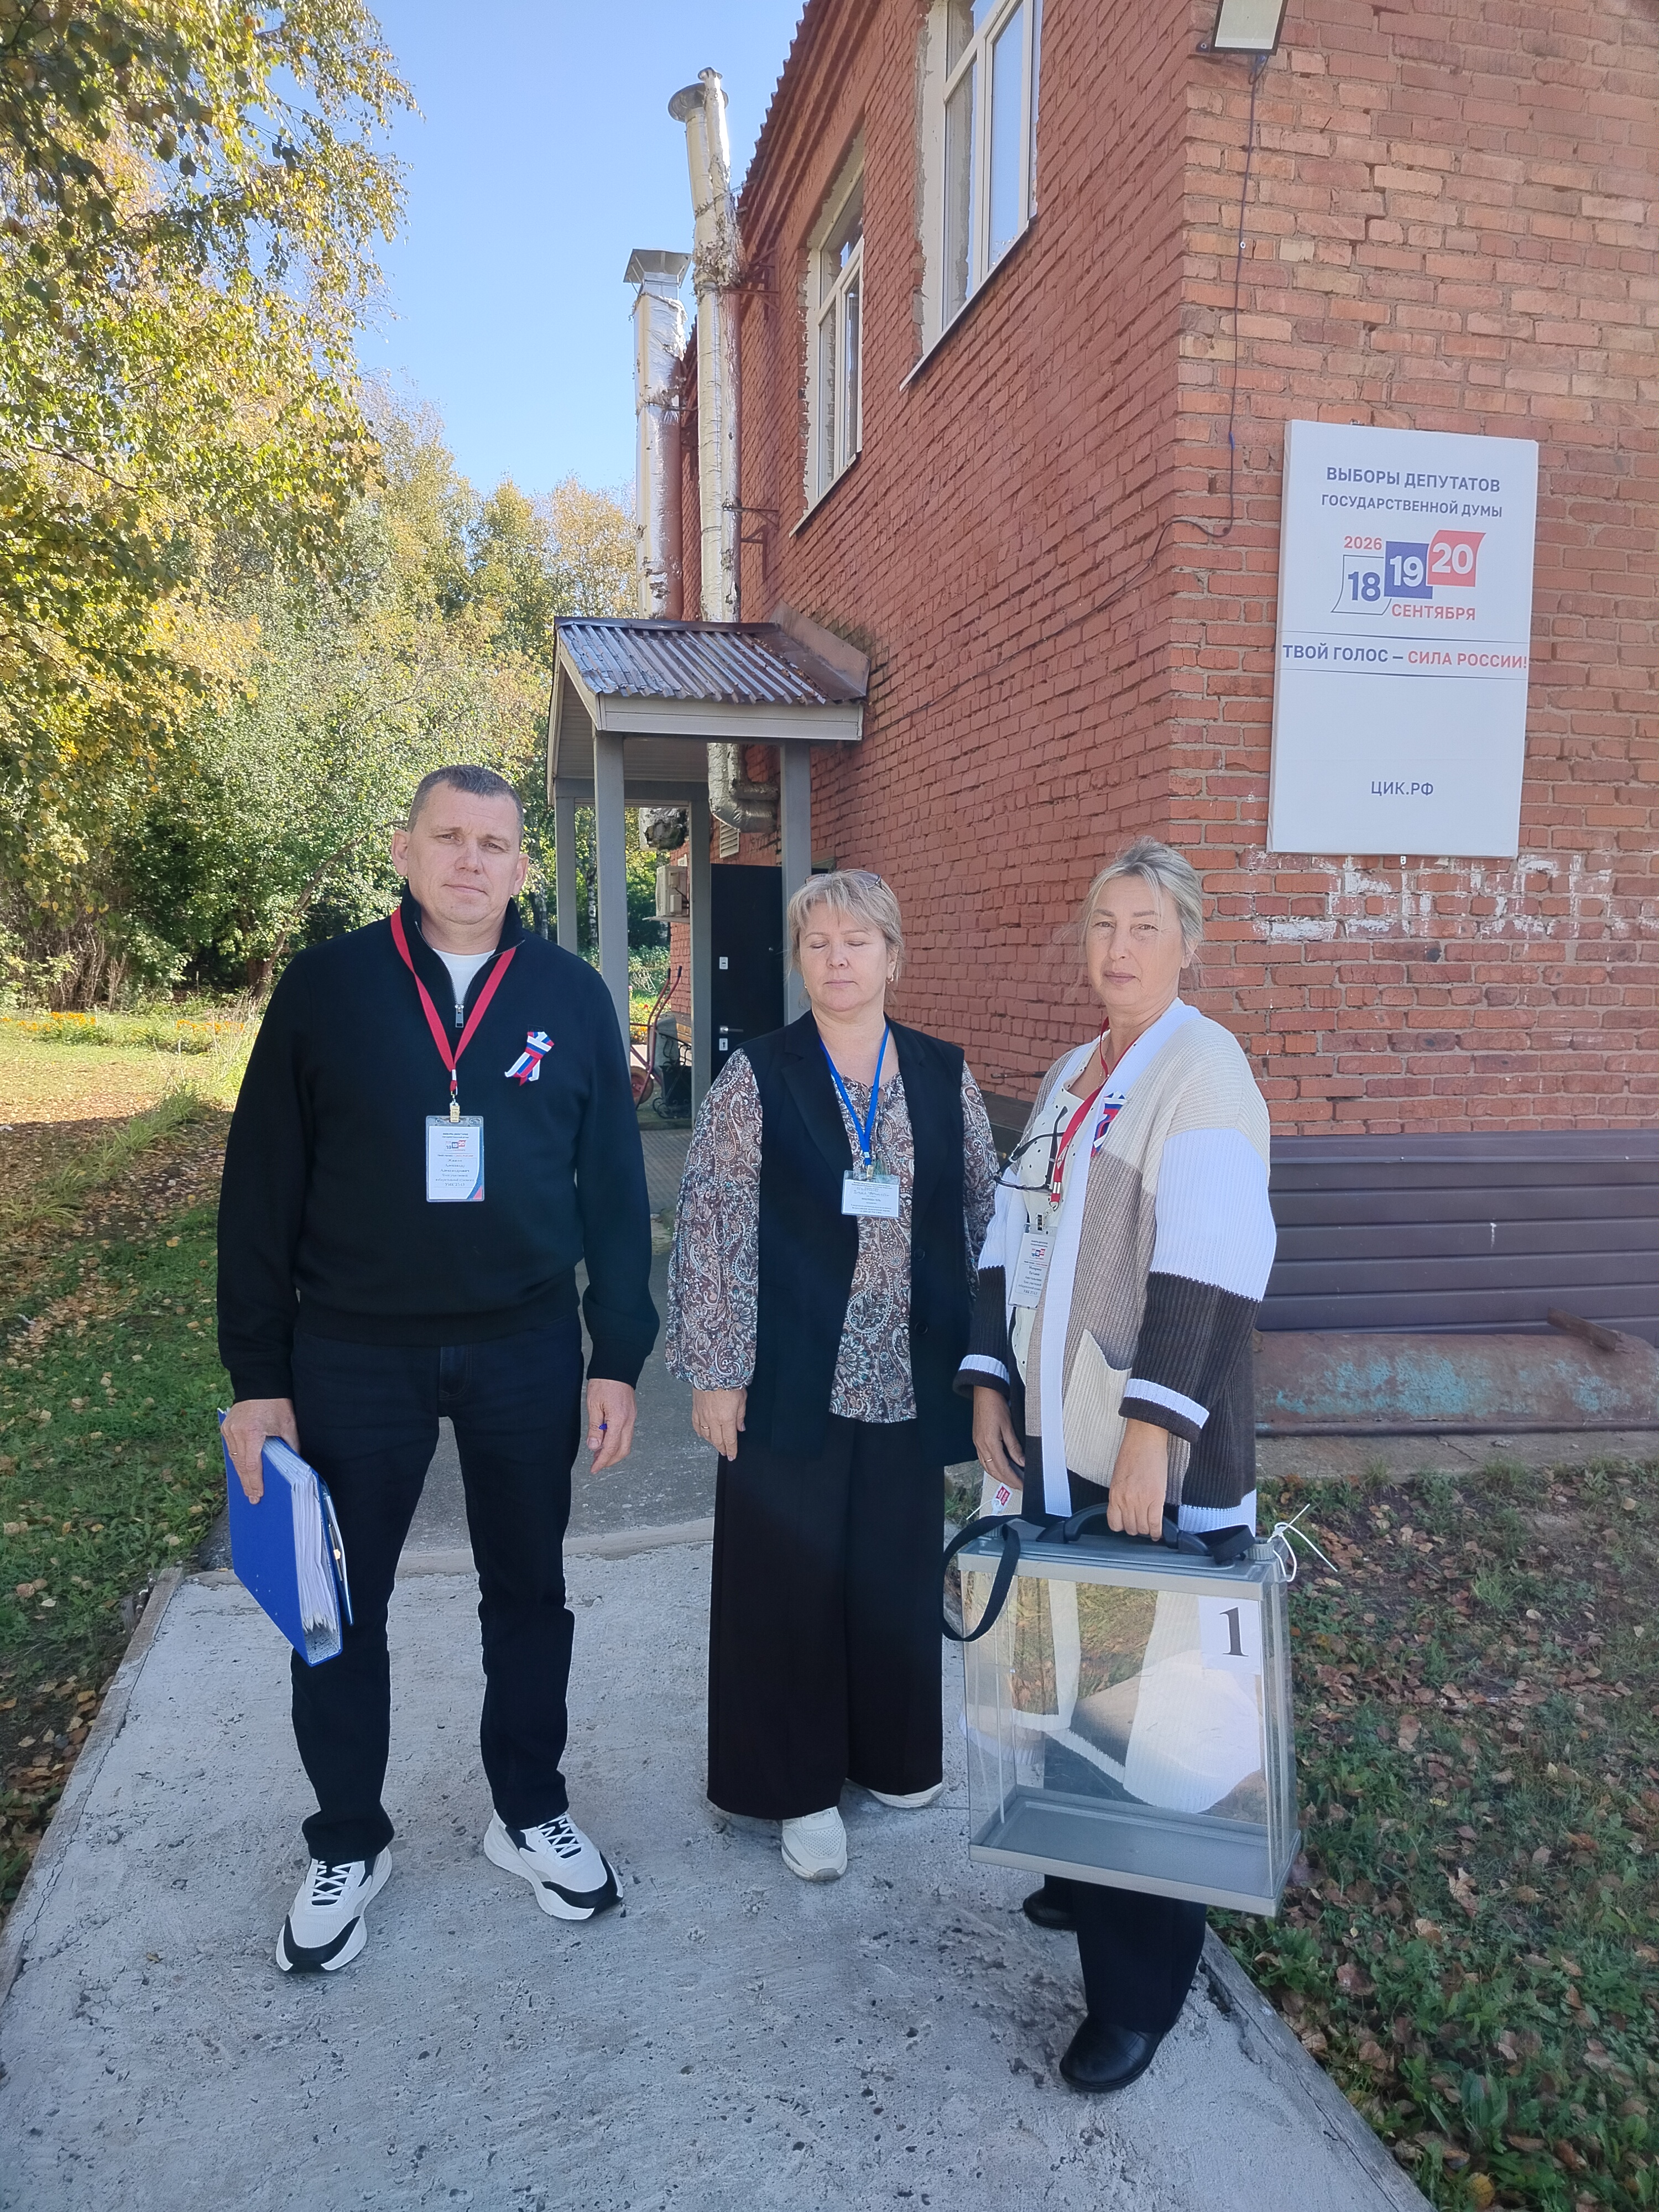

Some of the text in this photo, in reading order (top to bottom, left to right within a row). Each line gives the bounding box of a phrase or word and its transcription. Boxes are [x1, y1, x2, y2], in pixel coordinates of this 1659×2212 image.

[1327, 467, 1500, 492] ВЫБОРЫ ДЕПУТАТОВ
[1322, 494, 1503, 518] ГОСУДАРСТВЕННОЙ ДУМЫ
[1344, 536, 1383, 550] 2026
[1348, 542, 1474, 602] 18 19 20
[1391, 604, 1476, 621] СЕНТЯБРЯ
[1283, 643, 1328, 659] ТВОЙ
[1333, 646, 1389, 662] ГОЛОС
[1407, 650, 1452, 666] СИЛА
[1457, 653, 1527, 669] РОССИИ!
[1371, 781, 1433, 796] ЦИК.РФ
[1219, 1606, 1249, 1656] 1
